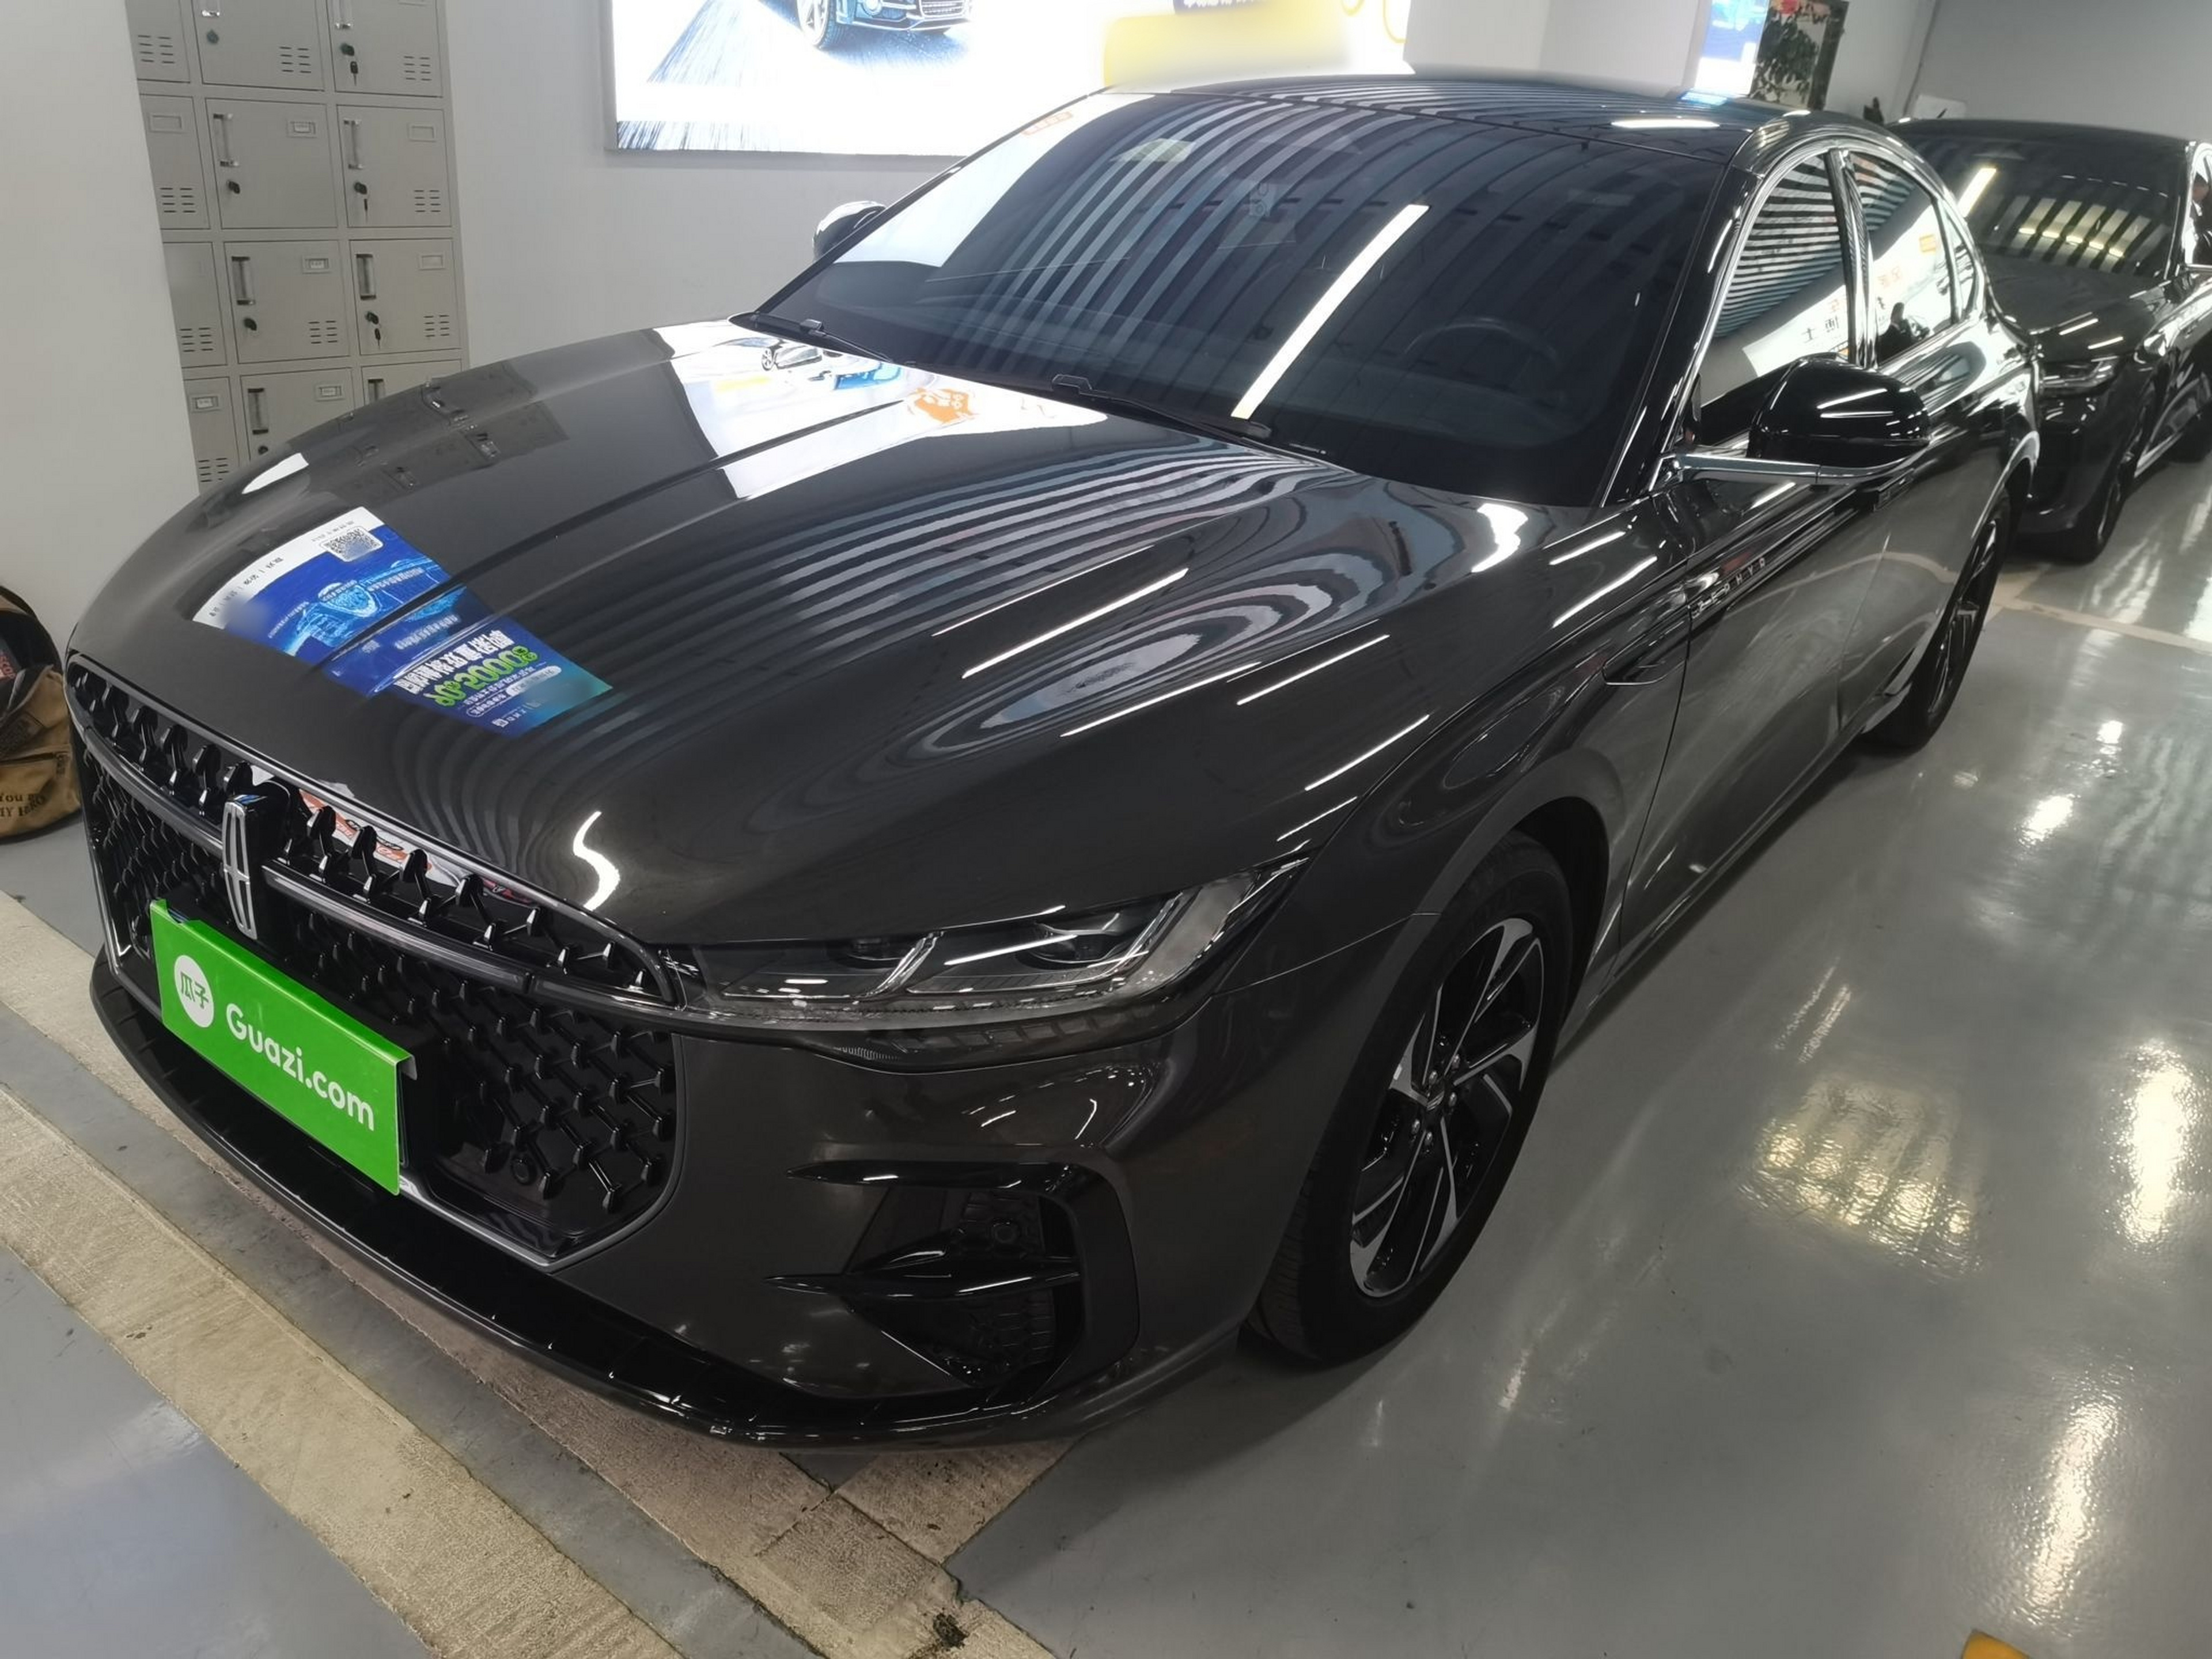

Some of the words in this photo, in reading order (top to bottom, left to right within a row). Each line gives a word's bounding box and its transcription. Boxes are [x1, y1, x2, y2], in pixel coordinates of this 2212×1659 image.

[1697, 558, 1766, 612] ZEPHYR
[179, 971, 209, 1009] 瓜子
[226, 1003, 375, 1131] Guazi.com
